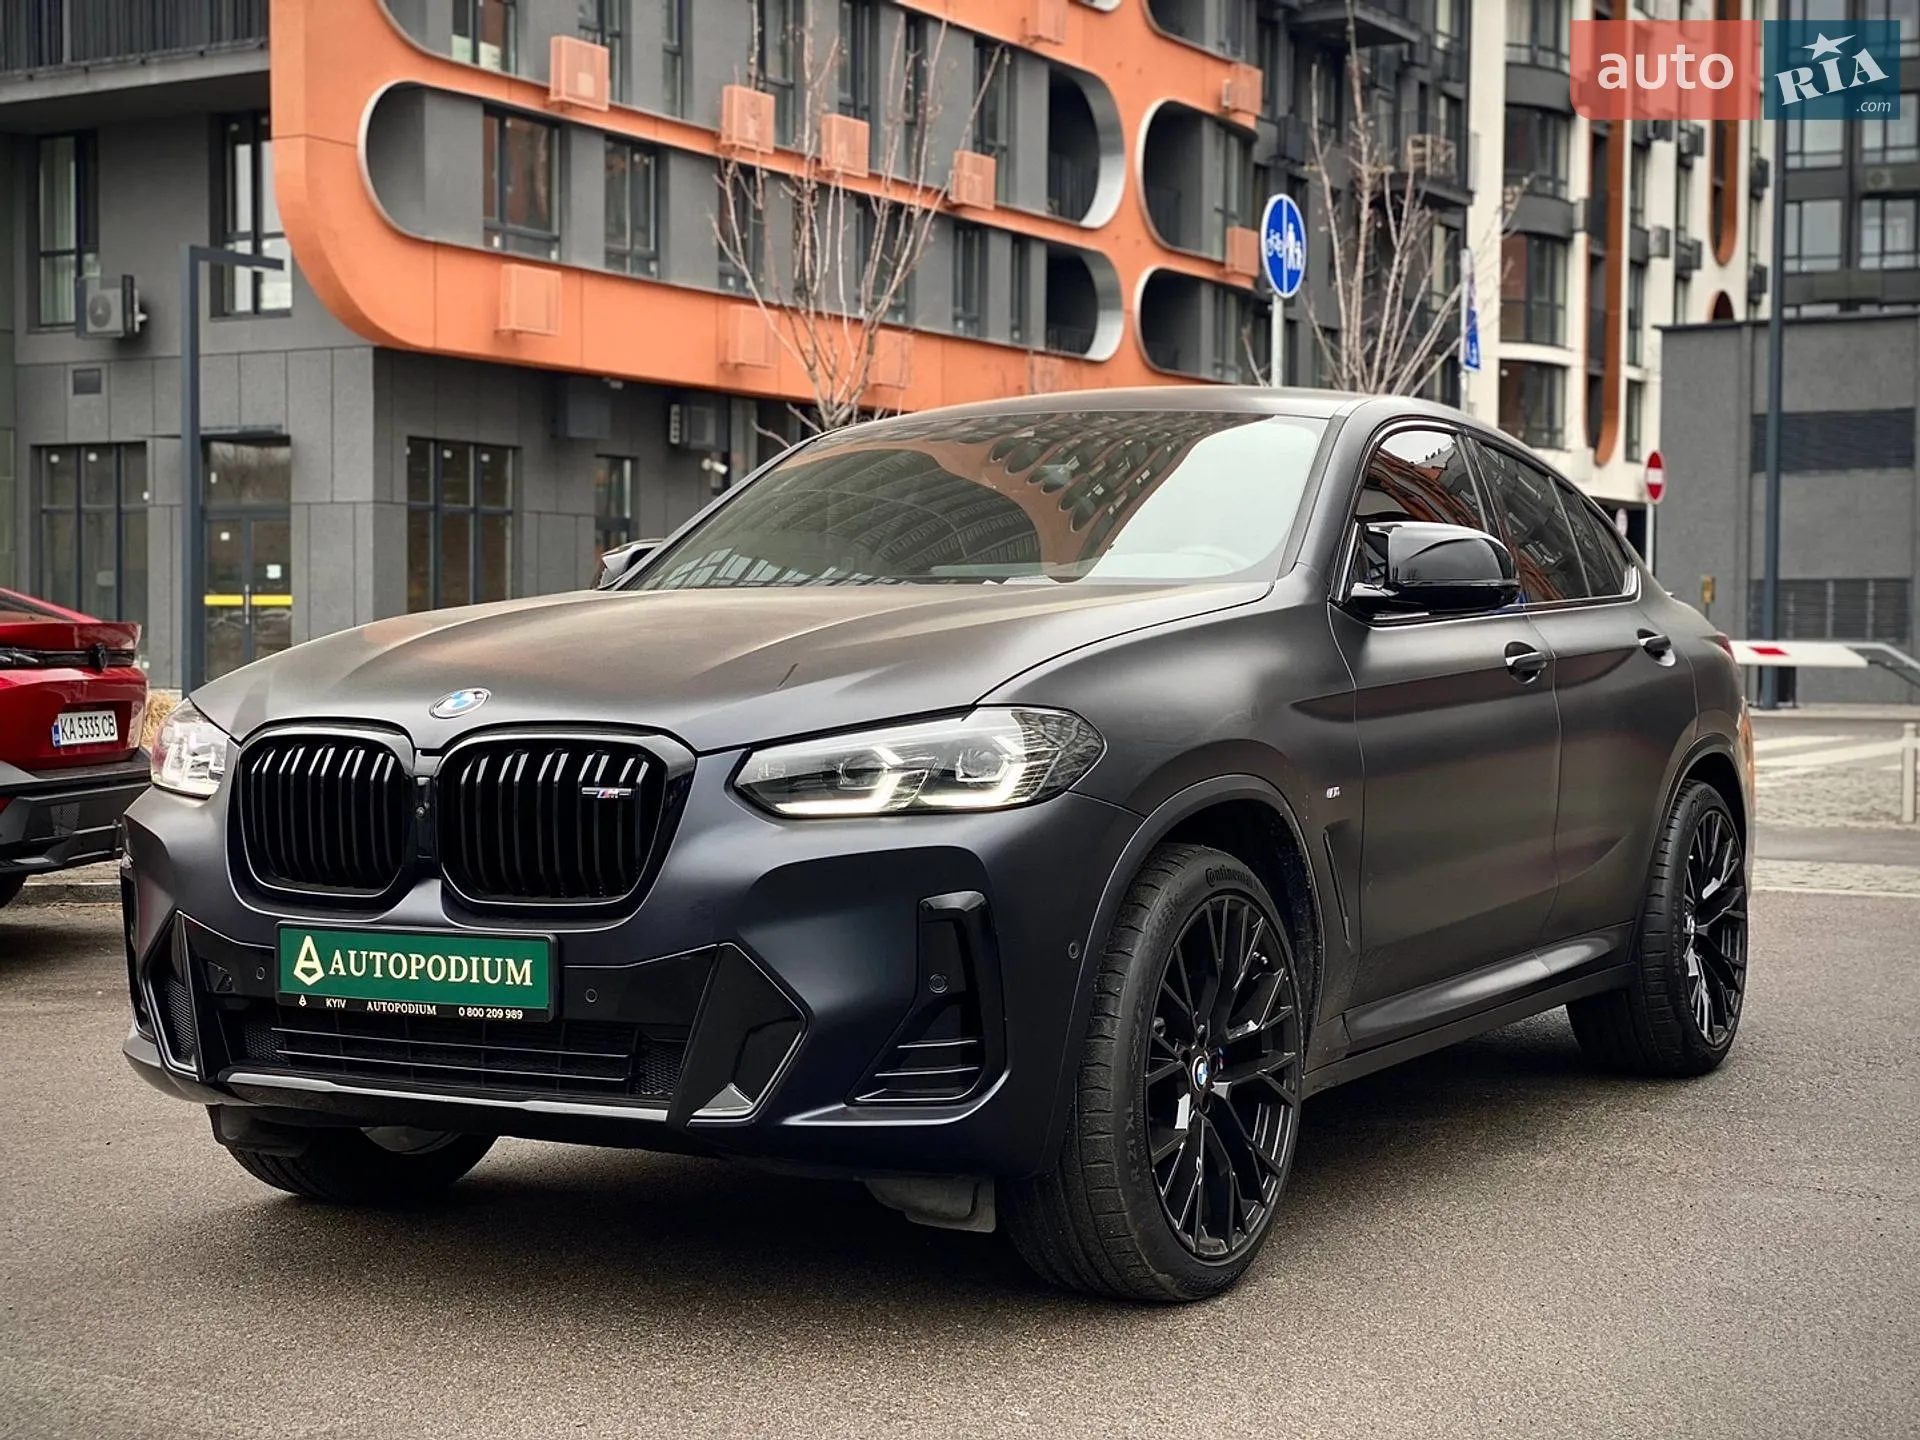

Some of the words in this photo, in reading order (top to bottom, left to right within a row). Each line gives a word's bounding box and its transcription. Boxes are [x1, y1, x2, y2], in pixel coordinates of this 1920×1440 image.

[60, 717, 77, 740] KA
[328, 949, 533, 986] AUTOPODIUM
[325, 998, 347, 1009] KYIV
[366, 1001, 437, 1016] AUTOPODIUM
[458, 1006, 466, 1016] 0
[466, 1007, 484, 1018] 800
[486, 1008, 504, 1018] 209
